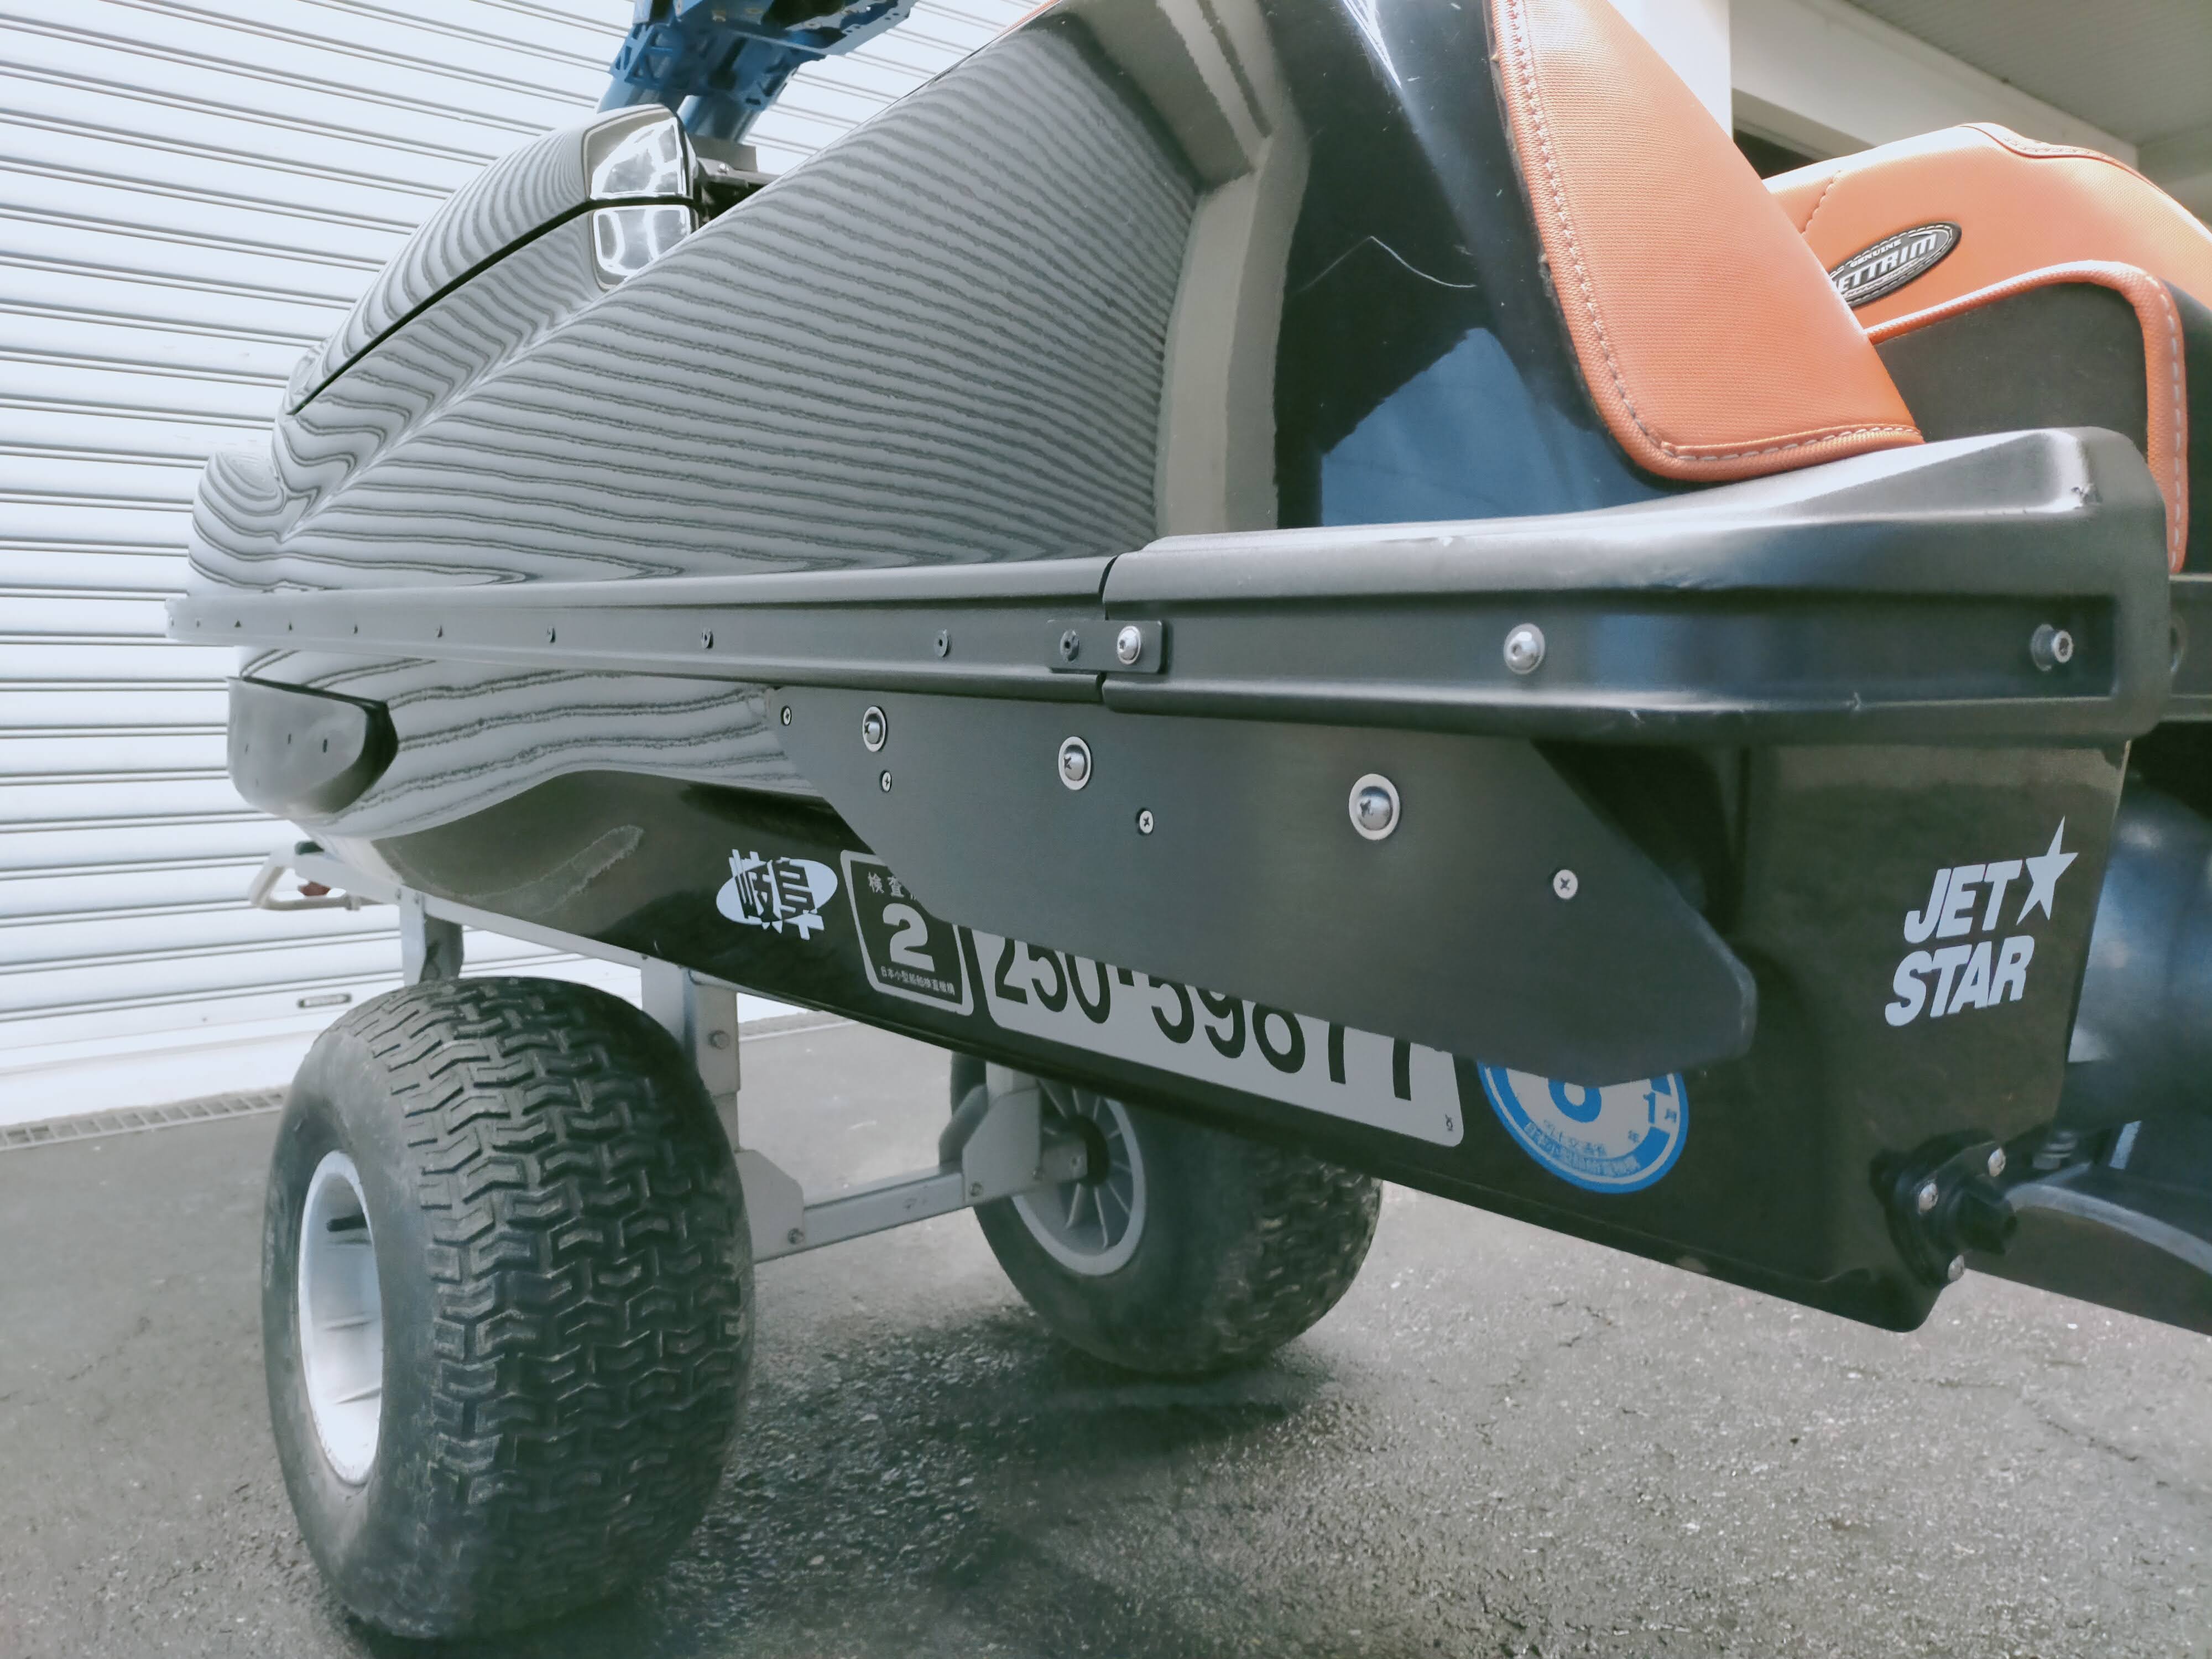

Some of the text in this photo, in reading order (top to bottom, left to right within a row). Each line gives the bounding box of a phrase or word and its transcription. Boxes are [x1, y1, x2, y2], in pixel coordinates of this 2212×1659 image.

[1834, 234, 1937, 293] ETTRIM
[1850, 238, 1901, 268] GENUINE
[868, 872, 916, 900] 検査
[1903, 859, 2023, 943] JET
[883, 903, 935, 972] 2
[1885, 935, 2035, 1026] STAR
